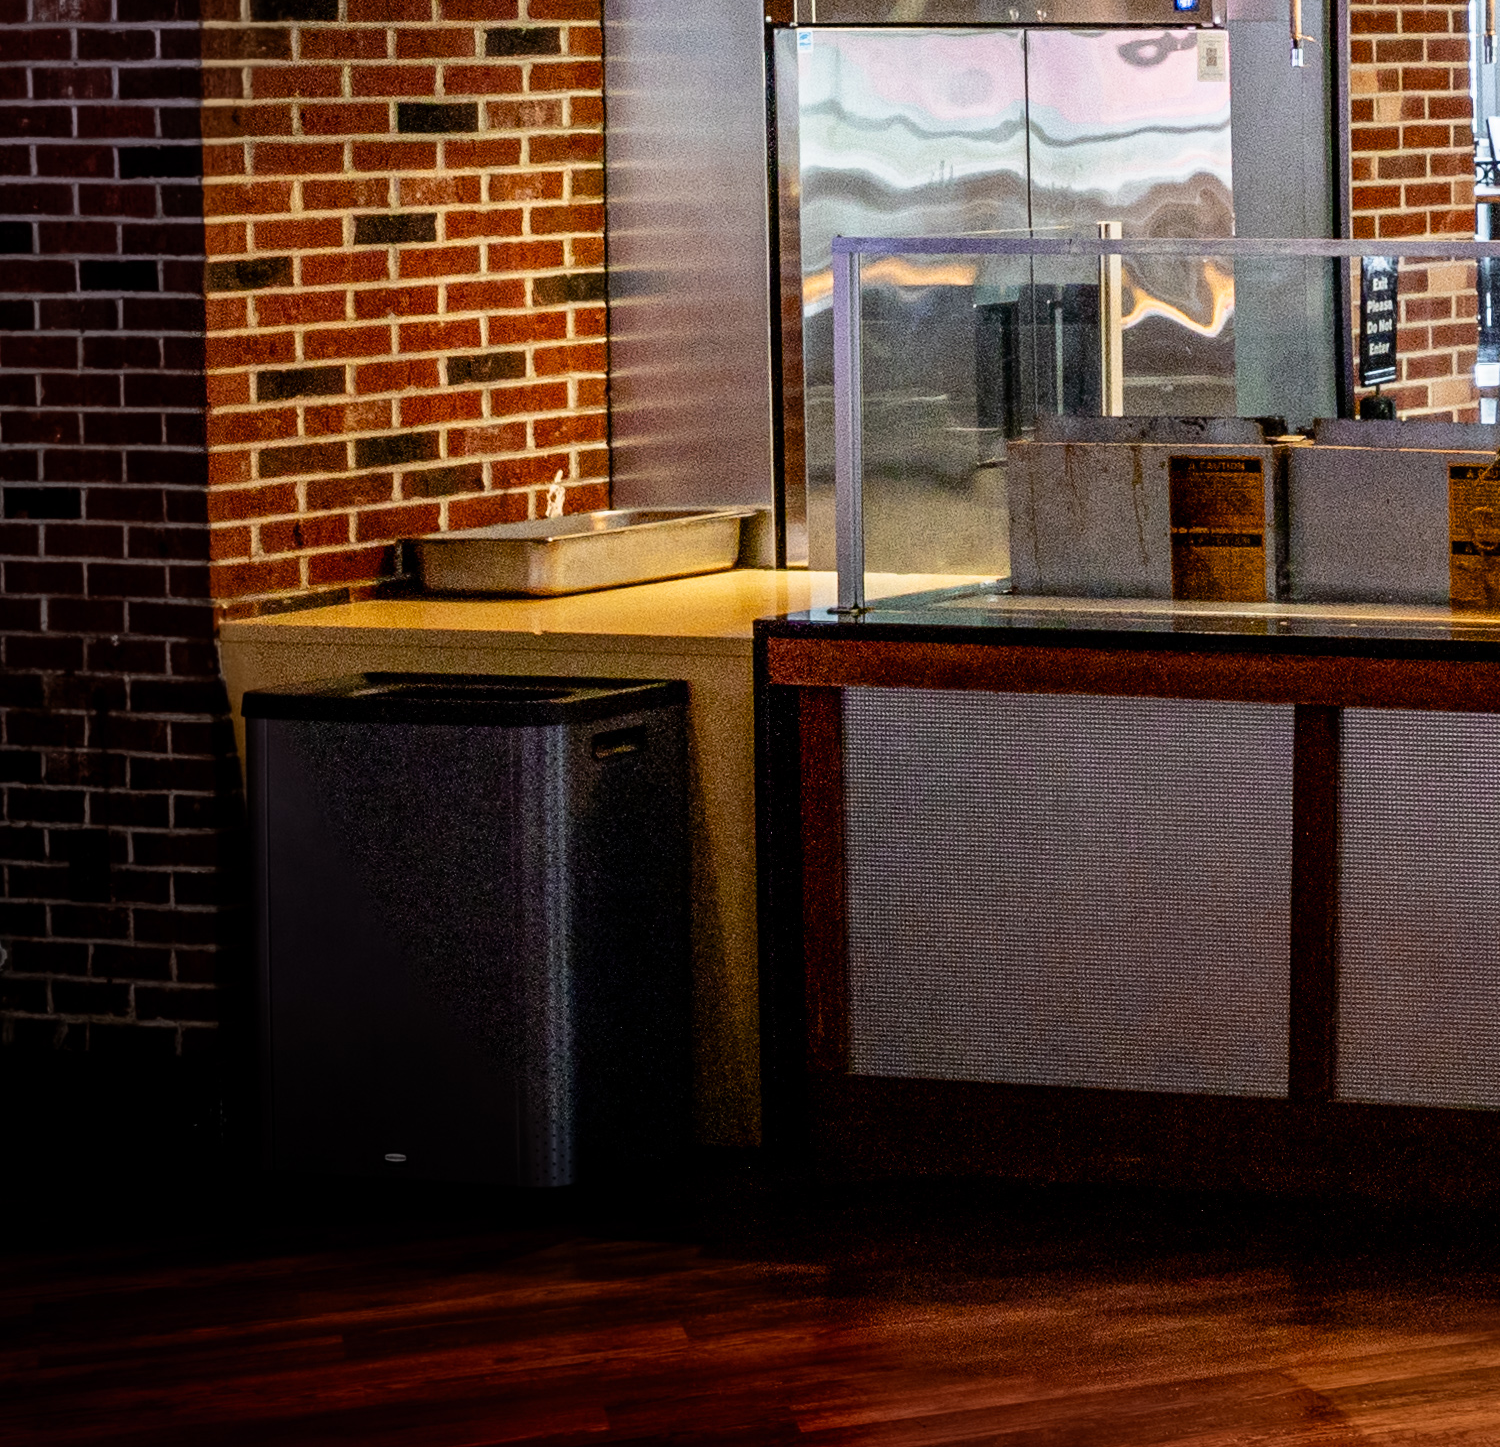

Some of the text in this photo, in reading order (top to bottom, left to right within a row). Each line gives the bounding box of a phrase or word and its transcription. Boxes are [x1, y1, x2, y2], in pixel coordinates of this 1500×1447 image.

[1372, 277, 1389, 292] Exit
[1366, 318, 1393, 335] Do Not
[1369, 342, 1391, 357] Enter
